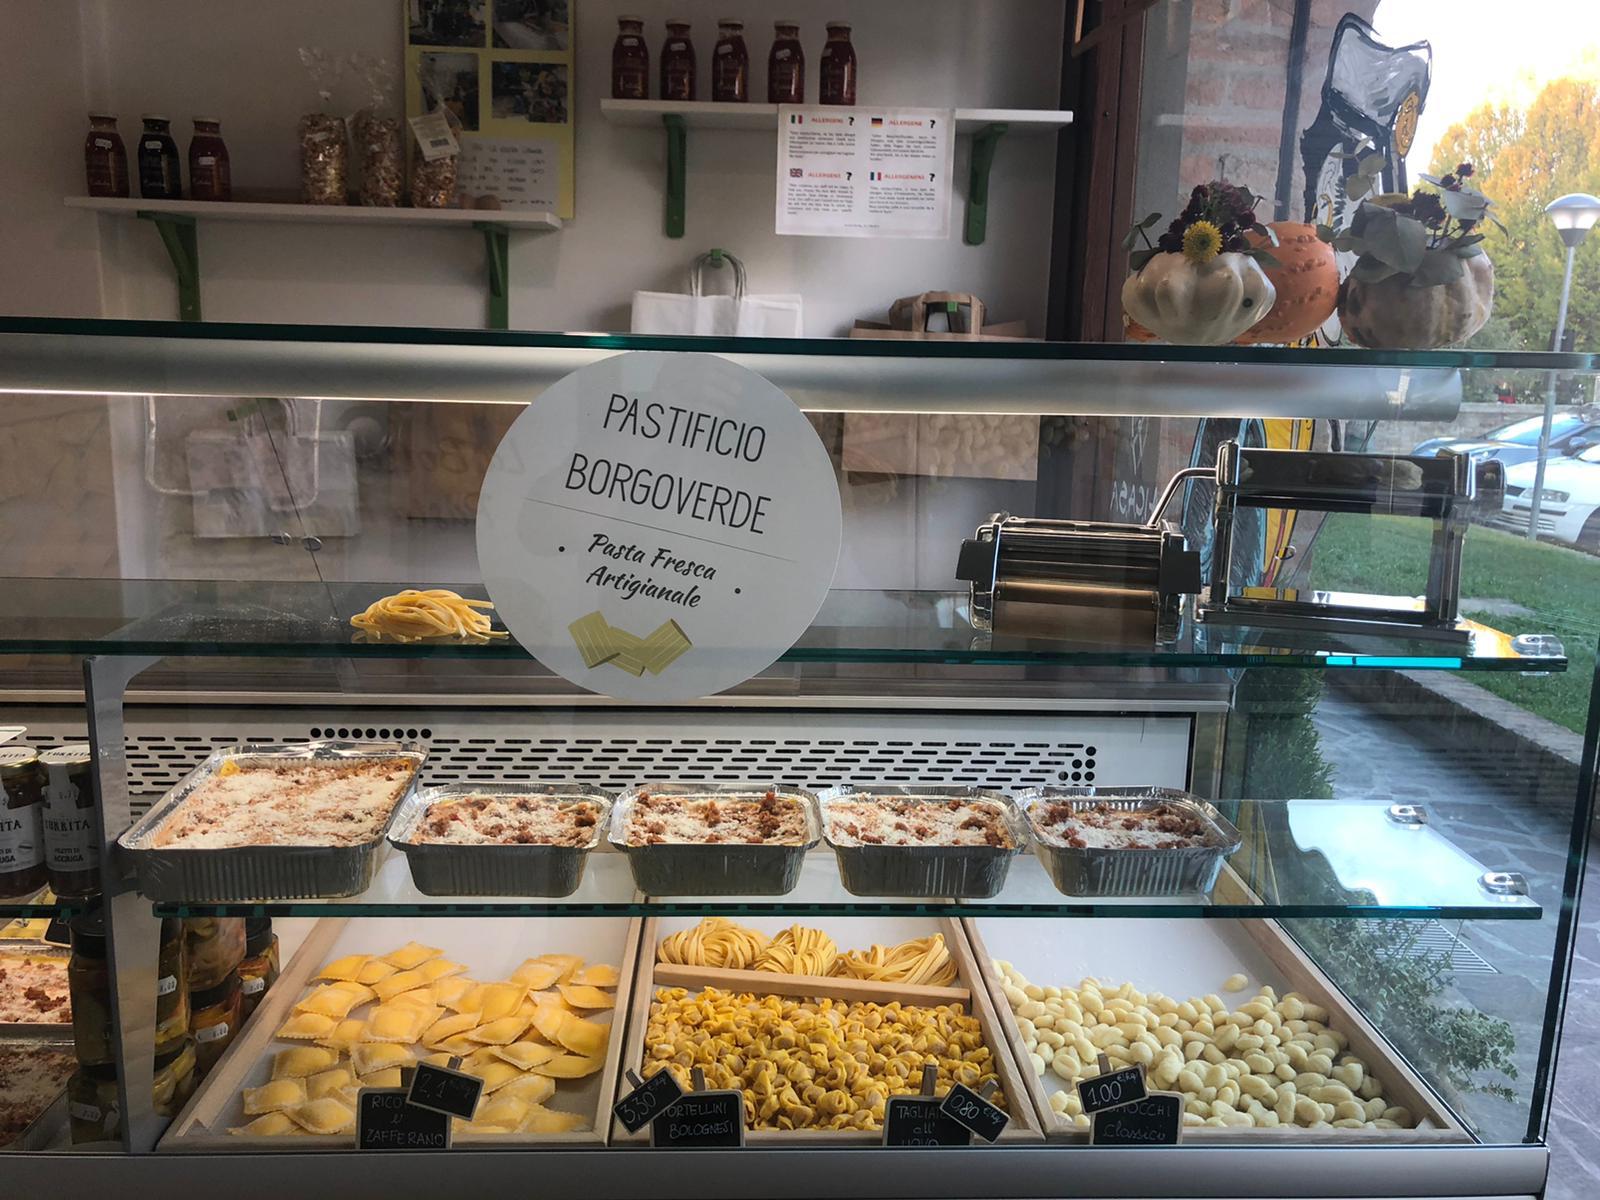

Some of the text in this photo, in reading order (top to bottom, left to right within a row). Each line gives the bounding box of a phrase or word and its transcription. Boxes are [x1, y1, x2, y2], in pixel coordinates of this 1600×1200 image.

[602, 394, 767, 463] PASTIFICIO
[564, 452, 773, 536] BORGOVERDE
[587, 533, 718, 581] Pasta Fresca
[585, 566, 702, 609] Artigianale
[619, 1090, 657, 1124] 3,30
[950, 1094, 980, 1120] 0,80
[1087, 1080, 1122, 1106] 1,00
